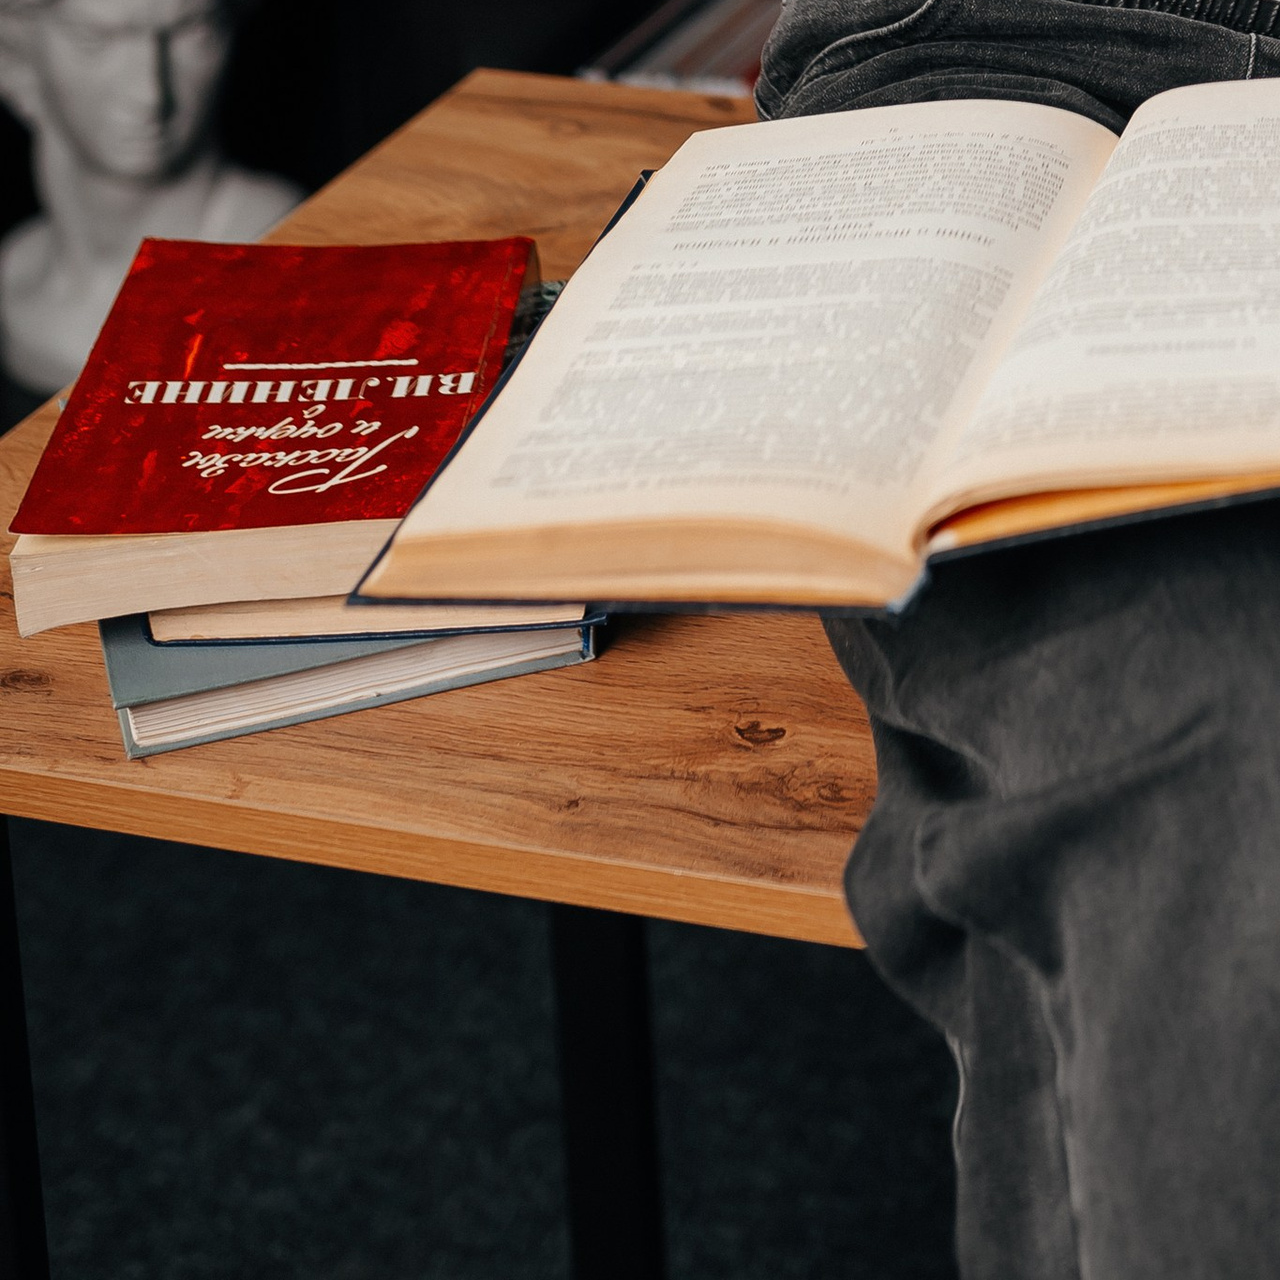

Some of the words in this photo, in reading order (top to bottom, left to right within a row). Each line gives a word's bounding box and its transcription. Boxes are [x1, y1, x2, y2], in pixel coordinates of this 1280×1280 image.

[123, 377, 381, 405] ЛЕНИНЕ
[302, 403, 327, 419] о
[201, 416, 344, 443] очерки
[350, 419, 382, 436] и
[181, 425, 420, 495] Рассказы
